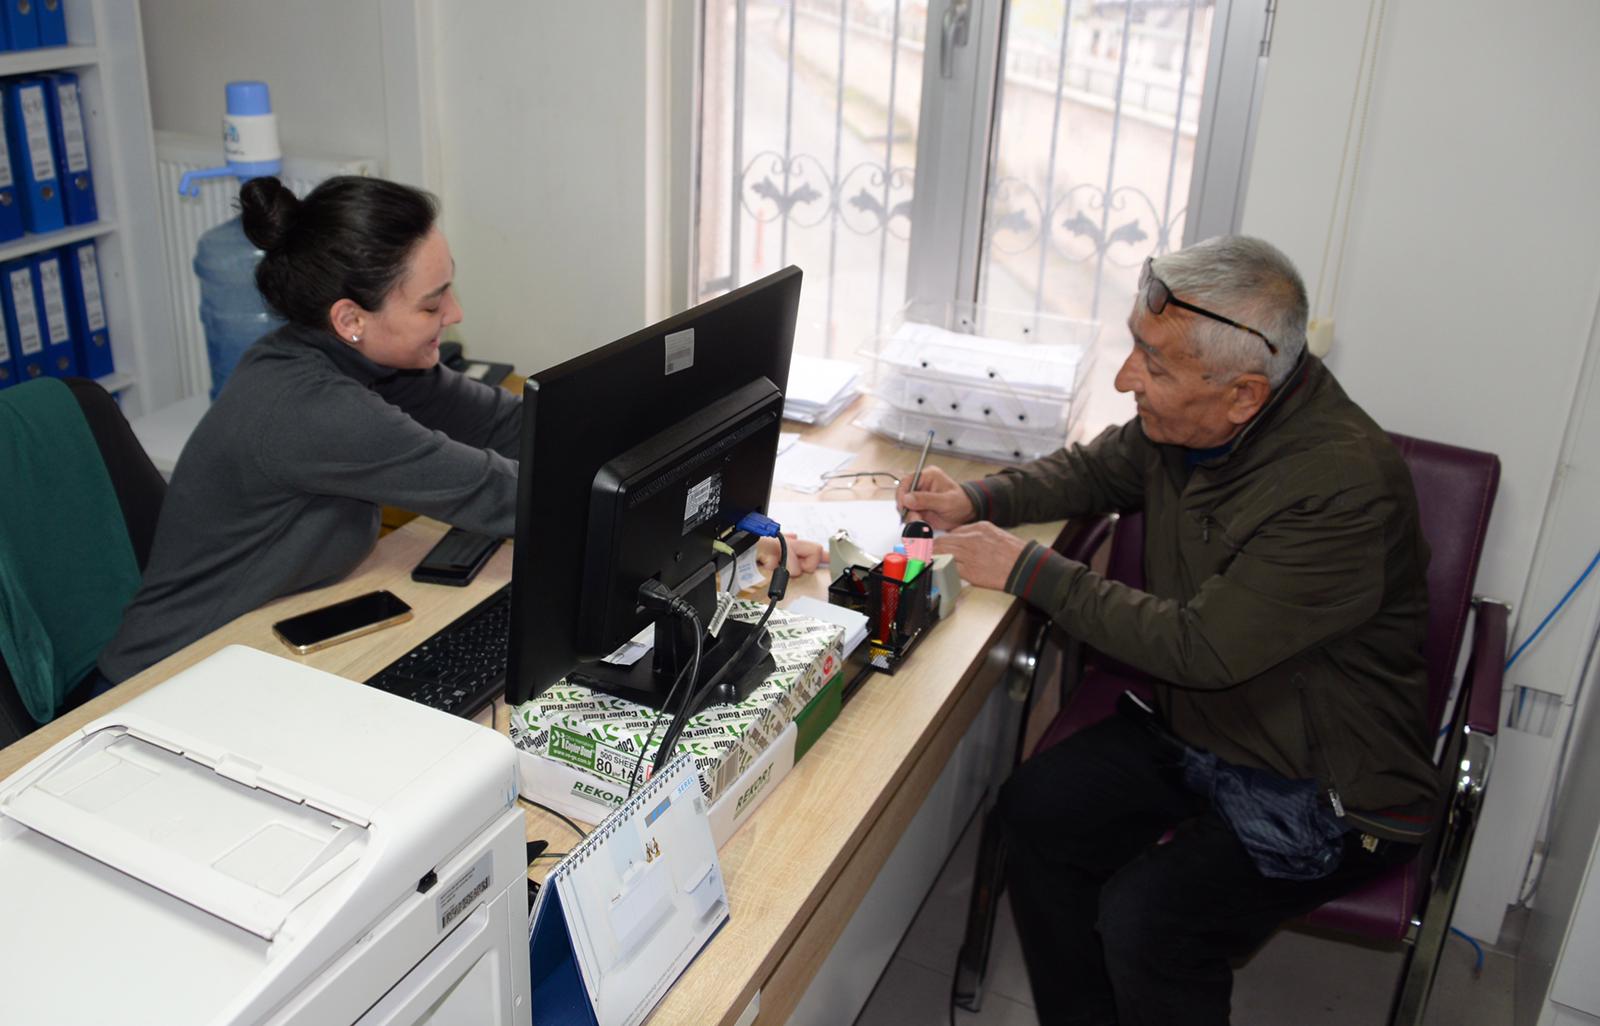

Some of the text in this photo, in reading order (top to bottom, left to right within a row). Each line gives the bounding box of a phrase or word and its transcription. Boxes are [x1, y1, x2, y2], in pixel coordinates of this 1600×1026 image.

[540, 702, 596, 716] Copier Bond
[582, 710, 638, 720] Copier Bond
[718, 712, 740, 720] Bond
[626, 721, 649, 729] Bond
[694, 726, 725, 736] Copier
[600, 751, 612, 760] 500
[596, 758, 612, 775] 80
[573, 782, 624, 805] REKOR
